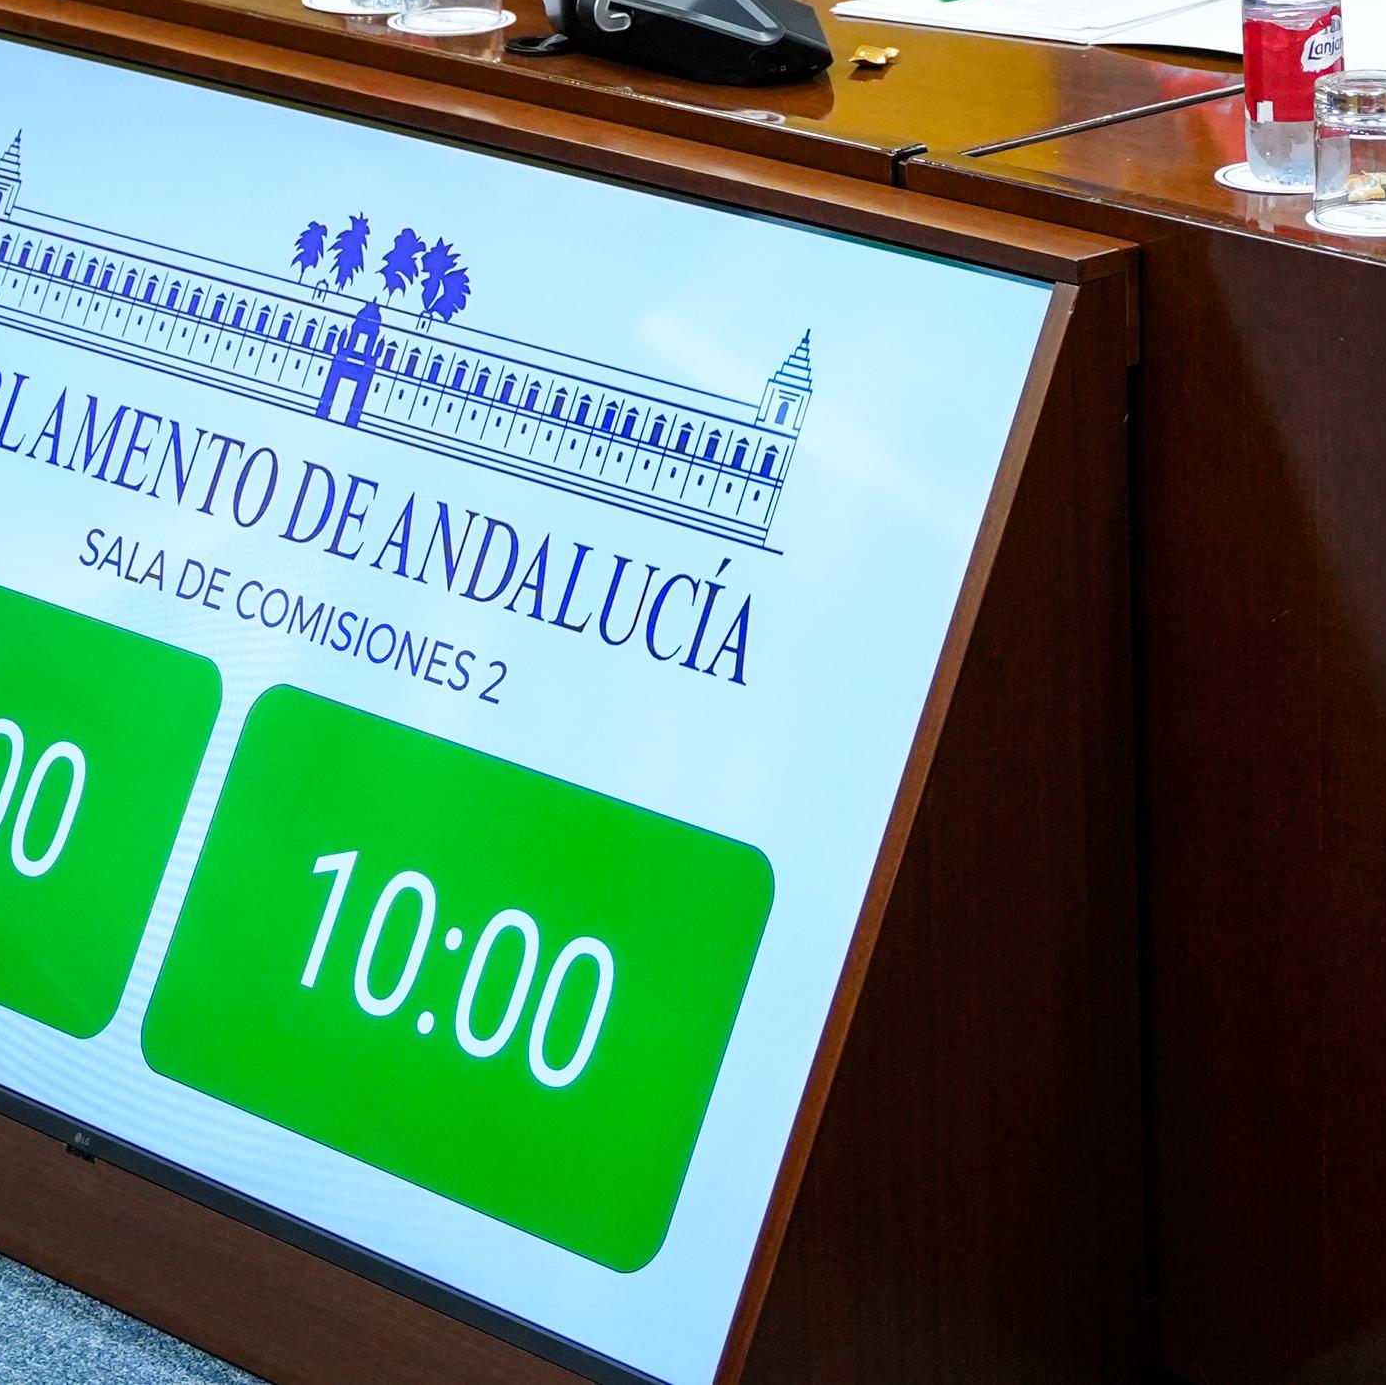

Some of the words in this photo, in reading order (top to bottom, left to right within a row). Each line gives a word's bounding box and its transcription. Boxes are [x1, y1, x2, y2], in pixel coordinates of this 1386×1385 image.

[78, 528, 165, 592] SALA
[175, 558, 231, 611] DE
[236, 580, 477, 692] COMISIONES
[478, 660, 508, 705] 2
[278, 460, 377, 561] DE
[369, 491, 752, 687] ANDALUCÍA
[300, 850, 614, 1088] 10:00
